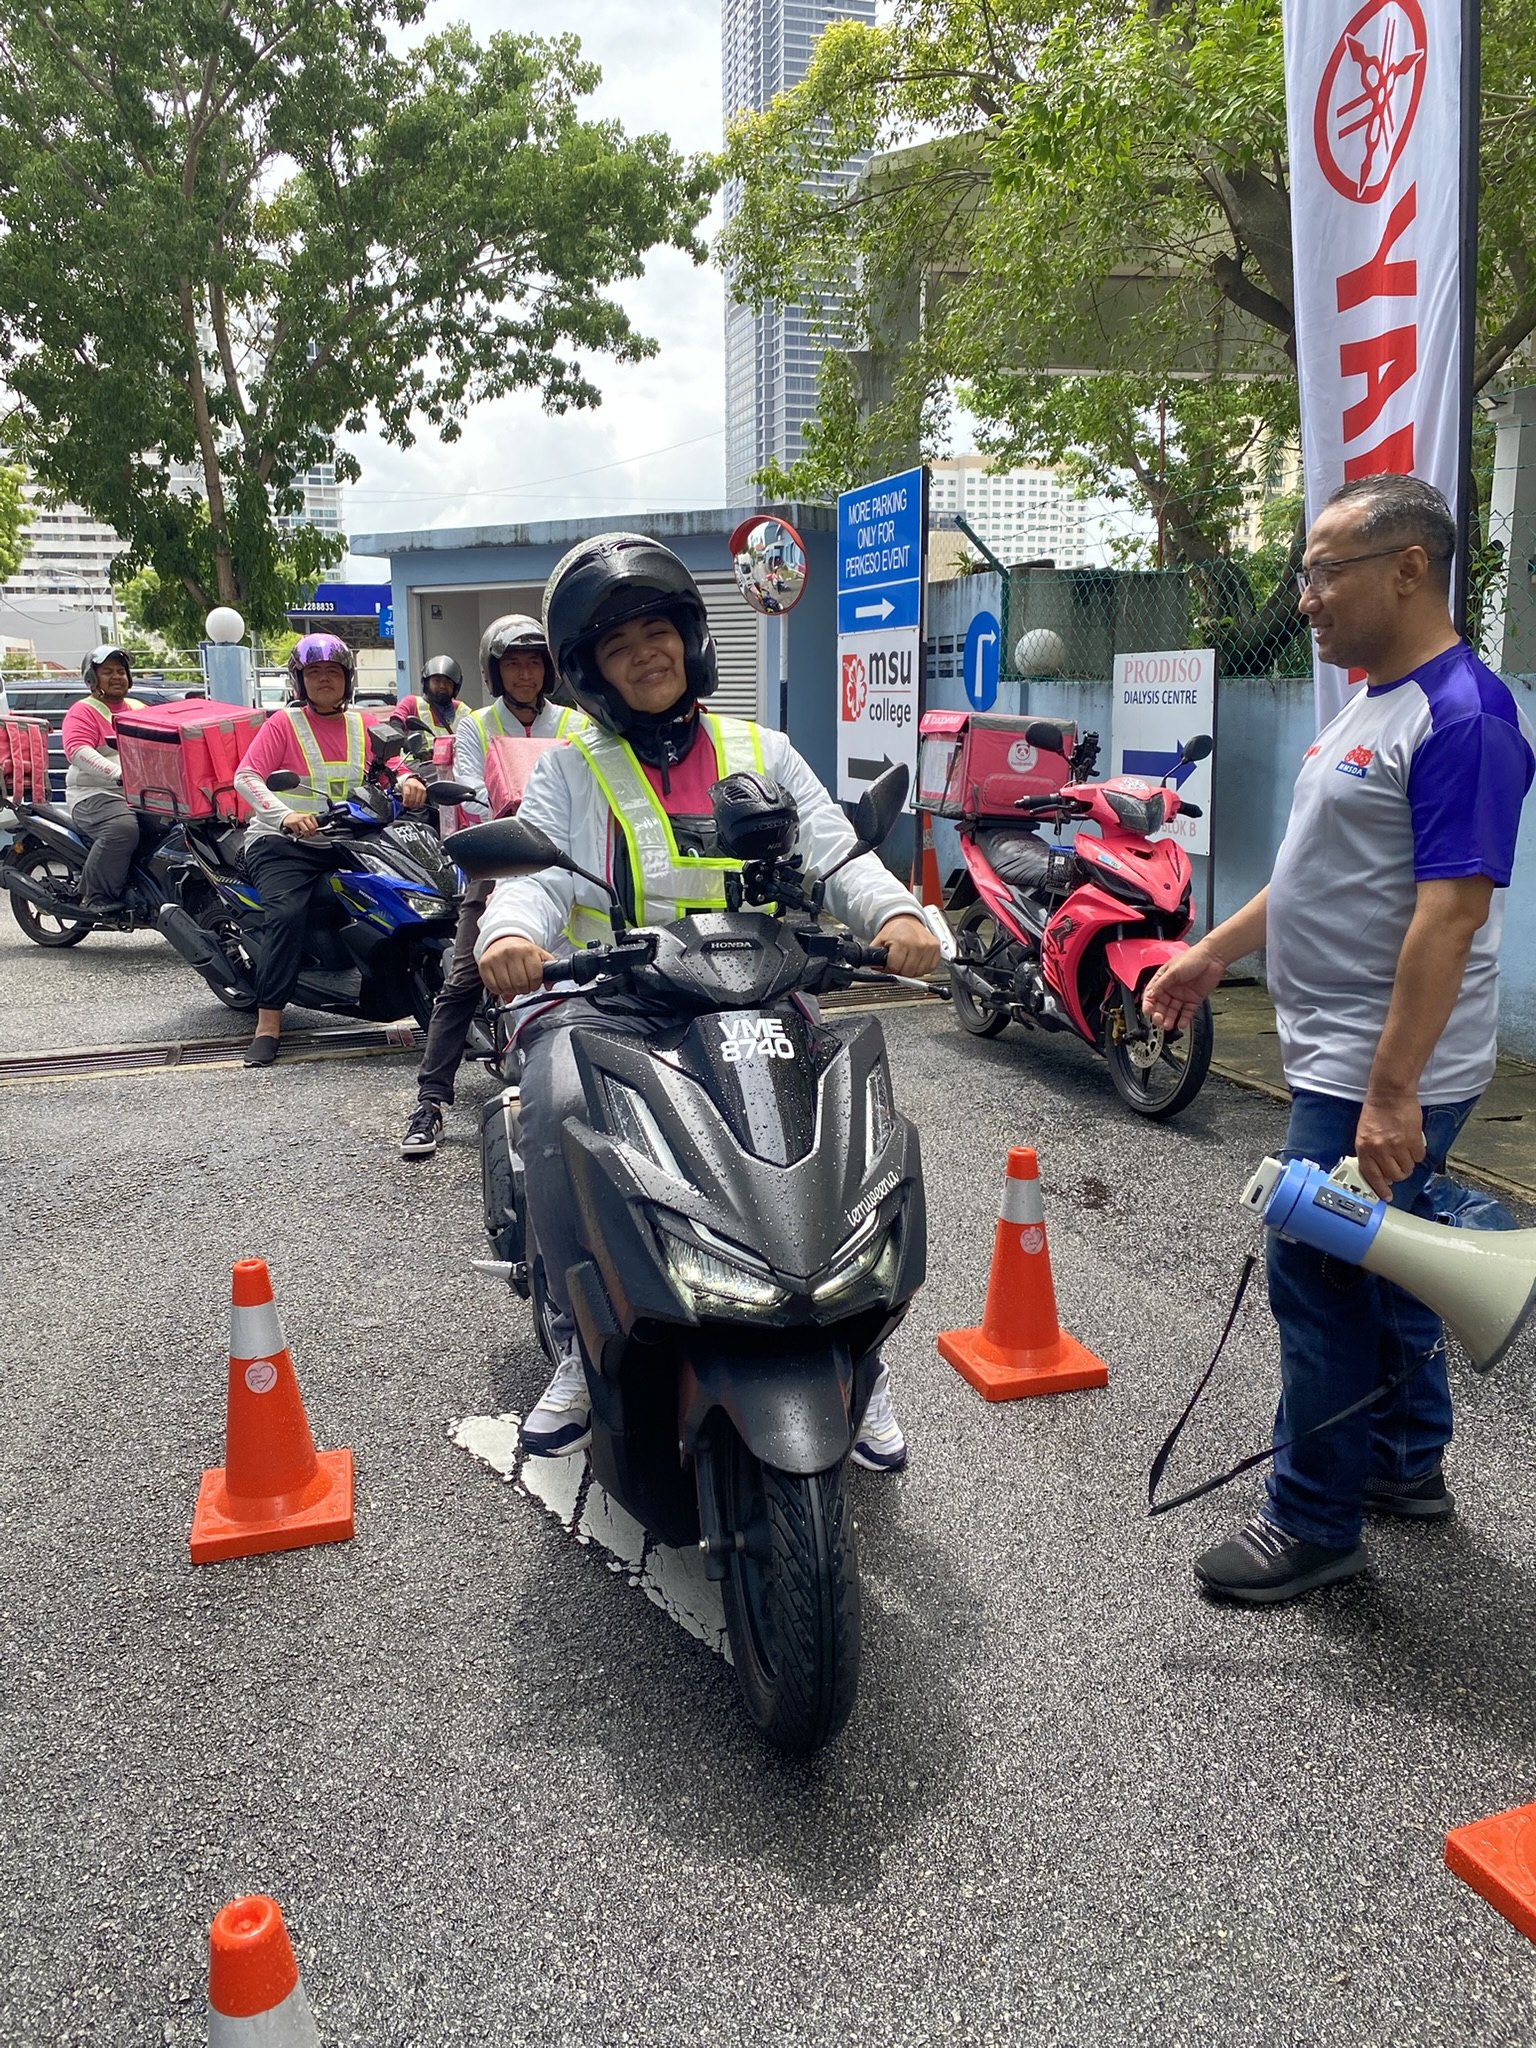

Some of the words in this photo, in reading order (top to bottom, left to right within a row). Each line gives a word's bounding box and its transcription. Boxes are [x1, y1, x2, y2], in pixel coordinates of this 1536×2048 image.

[848, 500, 871, 525] MORE
[872, 488, 907, 519] PARKING
[857, 524, 877, 549] ONLY
[878, 520, 895, 544] FOR
[845, 551, 880, 579] PERKESO
[882, 545, 911, 571] EVENT
[869, 651, 911, 685] msu
[1123, 657, 1201, 684] PRODISO
[1124, 690, 1160, 704] DIALYSIS
[1162, 690, 1197, 704] CENTRE
[869, 698, 911, 728] college
[711, 941, 752, 949] HONDA
[718, 1018, 786, 1040] VME
[720, 1037, 795, 1062] 8740
